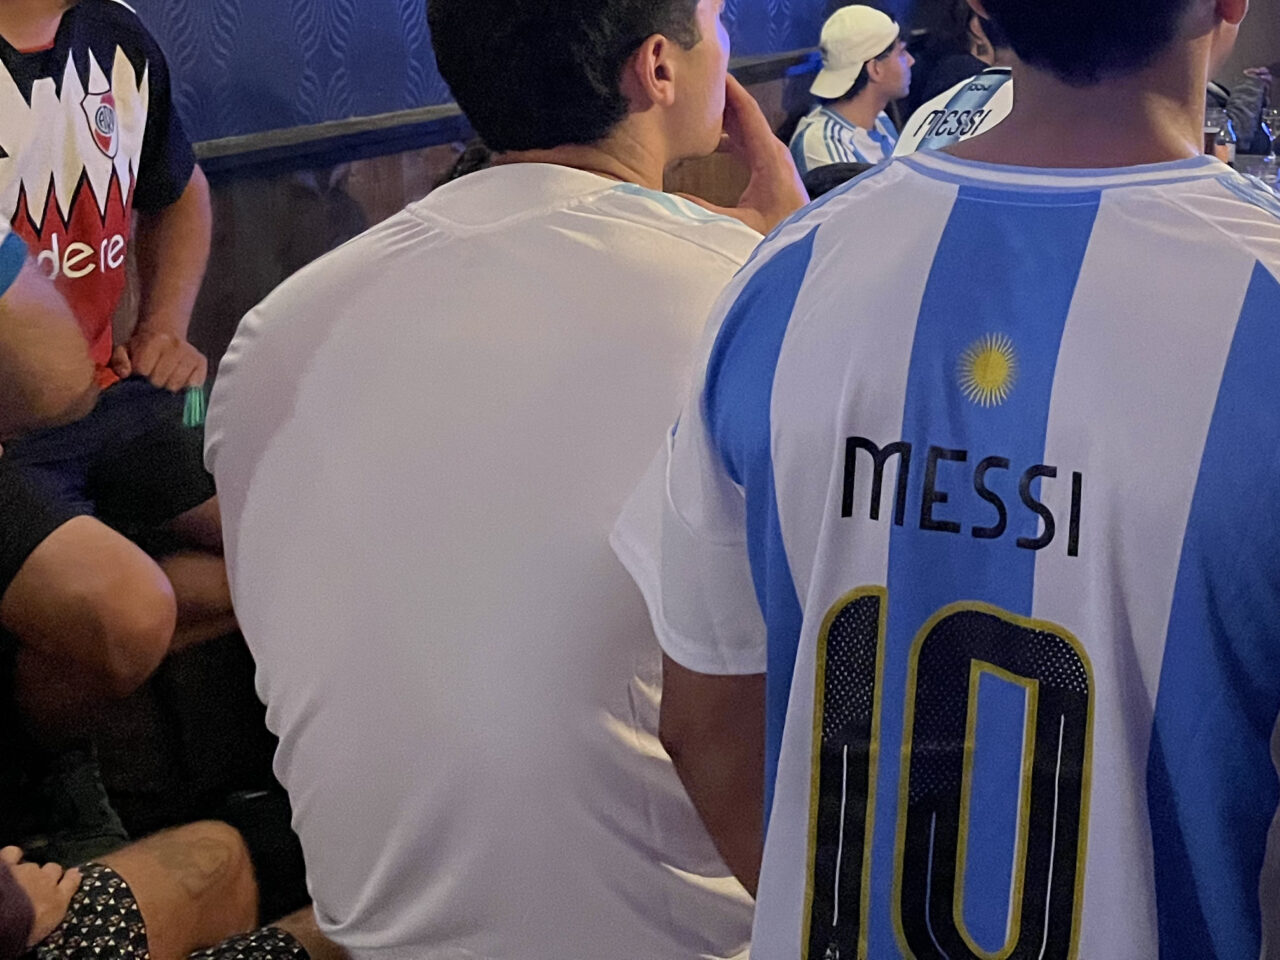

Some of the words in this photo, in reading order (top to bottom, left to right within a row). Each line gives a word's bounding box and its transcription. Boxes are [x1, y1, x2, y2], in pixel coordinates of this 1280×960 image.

[912, 109, 992, 137] MESSI
[841, 436, 1083, 557] MESSI
[801, 584, 1095, 960] 10
